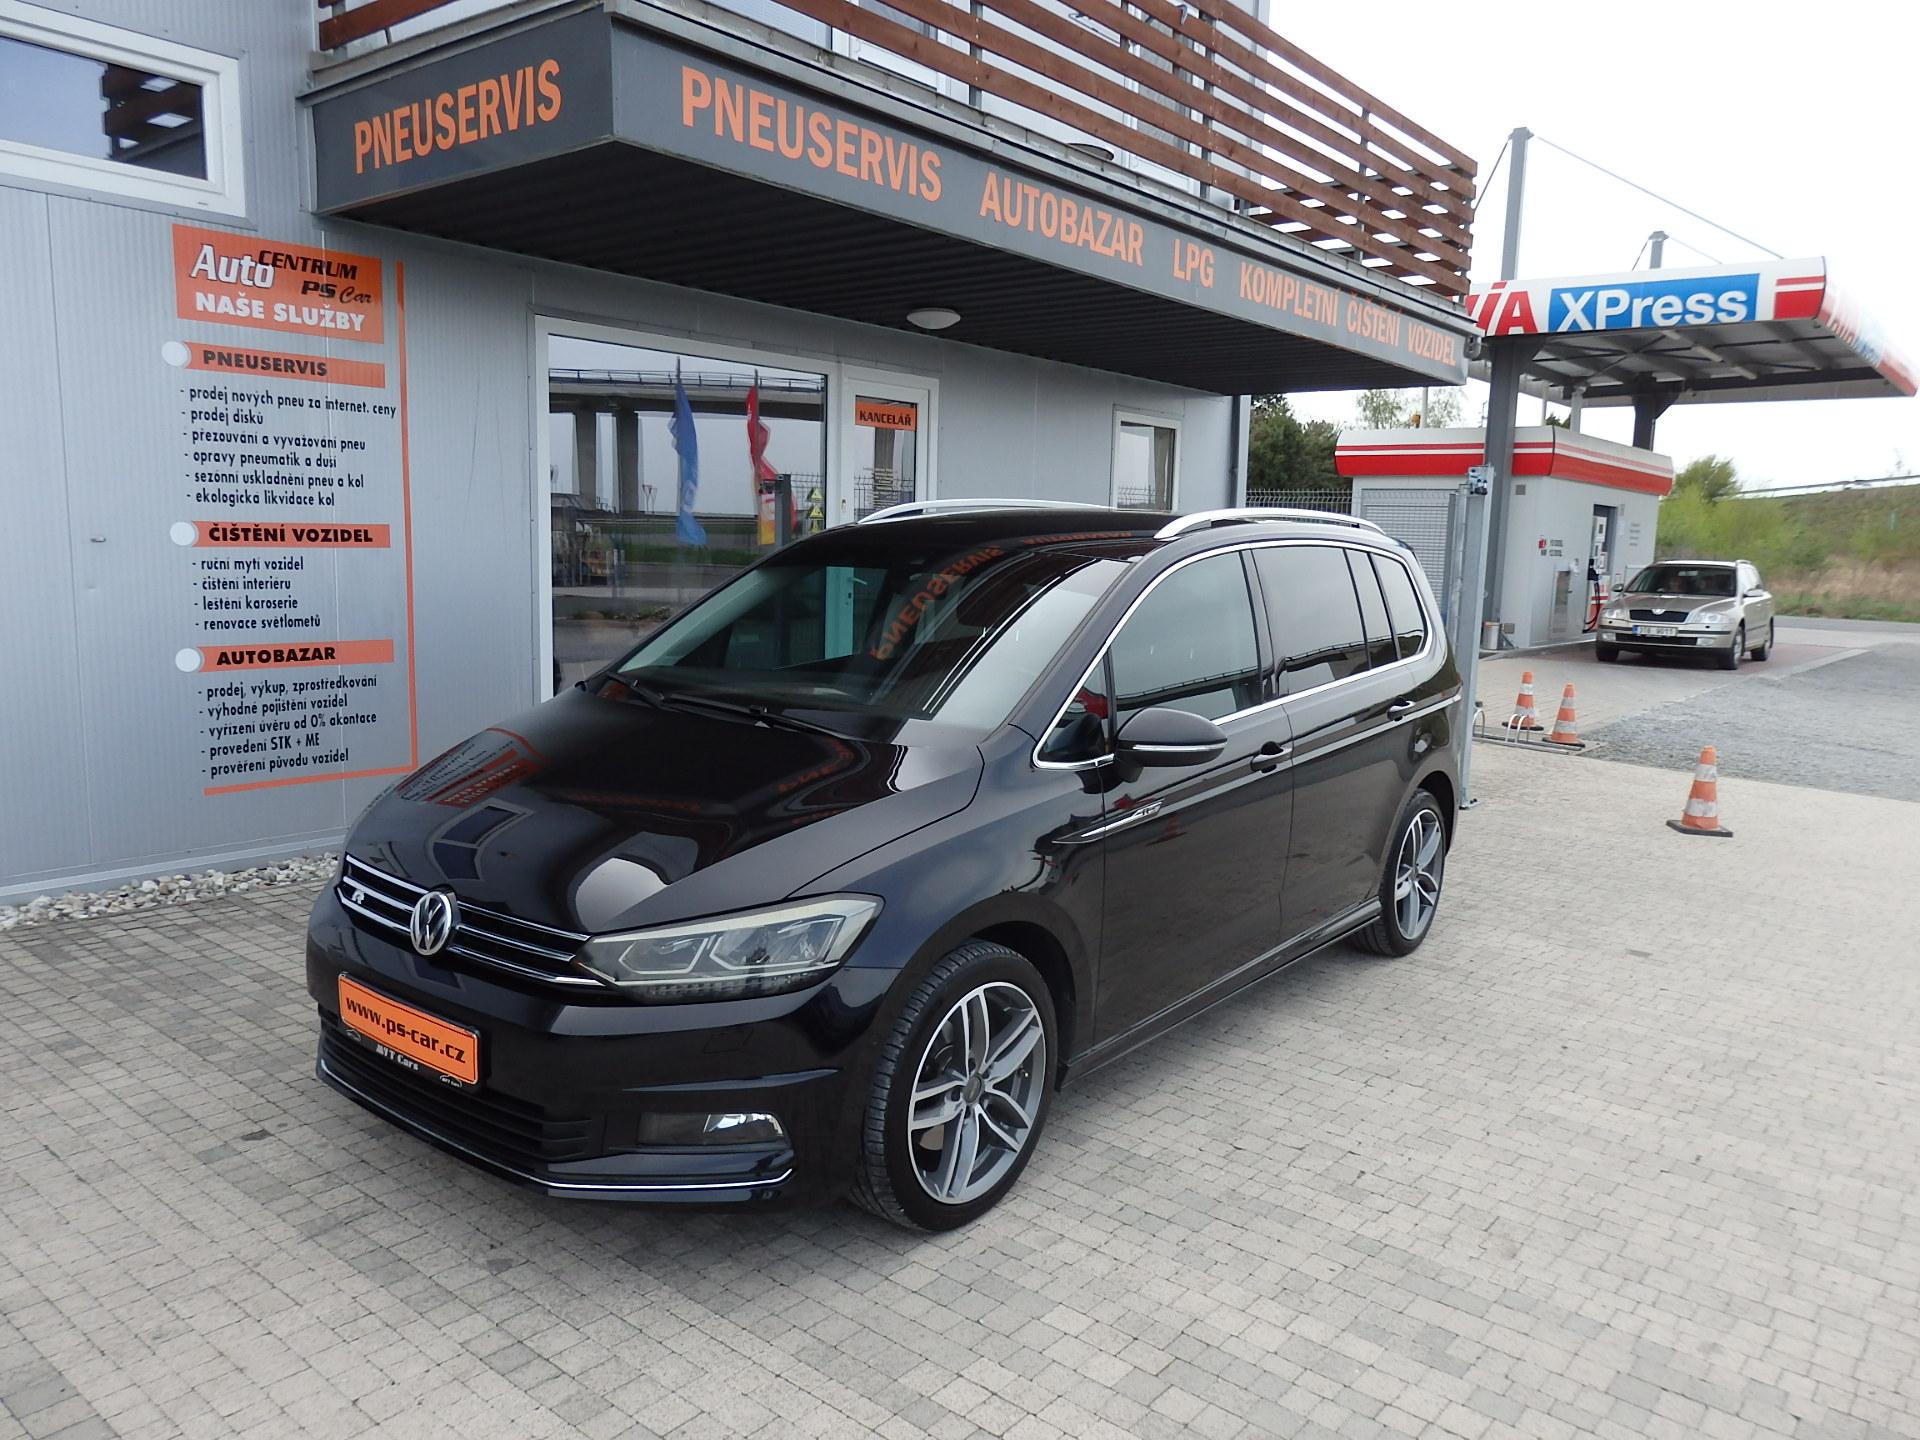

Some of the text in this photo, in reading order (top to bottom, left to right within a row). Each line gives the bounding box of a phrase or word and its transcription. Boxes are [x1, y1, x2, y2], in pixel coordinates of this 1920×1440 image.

[354, 59, 562, 174] PNEUSERVIS
[681, 66, 1457, 367] PNEUSERVIS AUTOBAZAR LPG KOMPLETNÍ ČIŠTĚNÍ VOZIDEL
[190, 244, 358, 289] Auto CENTRUM
[301, 280, 372, 304] PS Car
[195, 291, 365, 332] NAŠE SLUŽBY
[1556, 288, 1749, 332] XPress
[203, 350, 328, 376] PNEUSERVIS
[189, 386, 228, 405] prodej
[232, 390, 274, 407] nových
[277, 396, 305, 409] pneu
[308, 398, 321, 409] za
[373, 404, 397, 419] ceny
[191, 406, 229, 426] prodej
[262, 435, 270, 445] a
[340, 440, 366, 452] pneu
[193, 451, 236, 467] opravy
[240, 451, 301, 467] pneumatik
[305, 457, 312, 467] a
[242, 469, 305, 486] uskladnění
[308, 476, 335, 489] pneu
[337, 478, 345, 487] a
[348, 472, 364, 488] kol
[264, 489, 315, 506] likvidace
[318, 491, 335, 506] kol
[208, 523, 373, 543] ČIŠTĚNÍ VOZIDEL
[201, 557, 230, 570] ruční
[264, 555, 304, 570] vozidel
[245, 594, 298, 609] karoserie
[204, 613, 321, 630] renovace světlometů
[216, 647, 336, 666] AUTOBAZAR
[207, 681, 247, 701] prodej,
[208, 700, 258, 720] výhodné
[311, 693, 348, 709] vozidel
[294, 714, 307, 729] od
[330, 711, 377, 726] akontace
[210, 738, 267, 760] provedení
[270, 735, 292, 750] STK
[305, 732, 320, 747] ME
[312, 747, 349, 765] vozidel
[345, 997, 467, 1064] www.ps-car.cz
